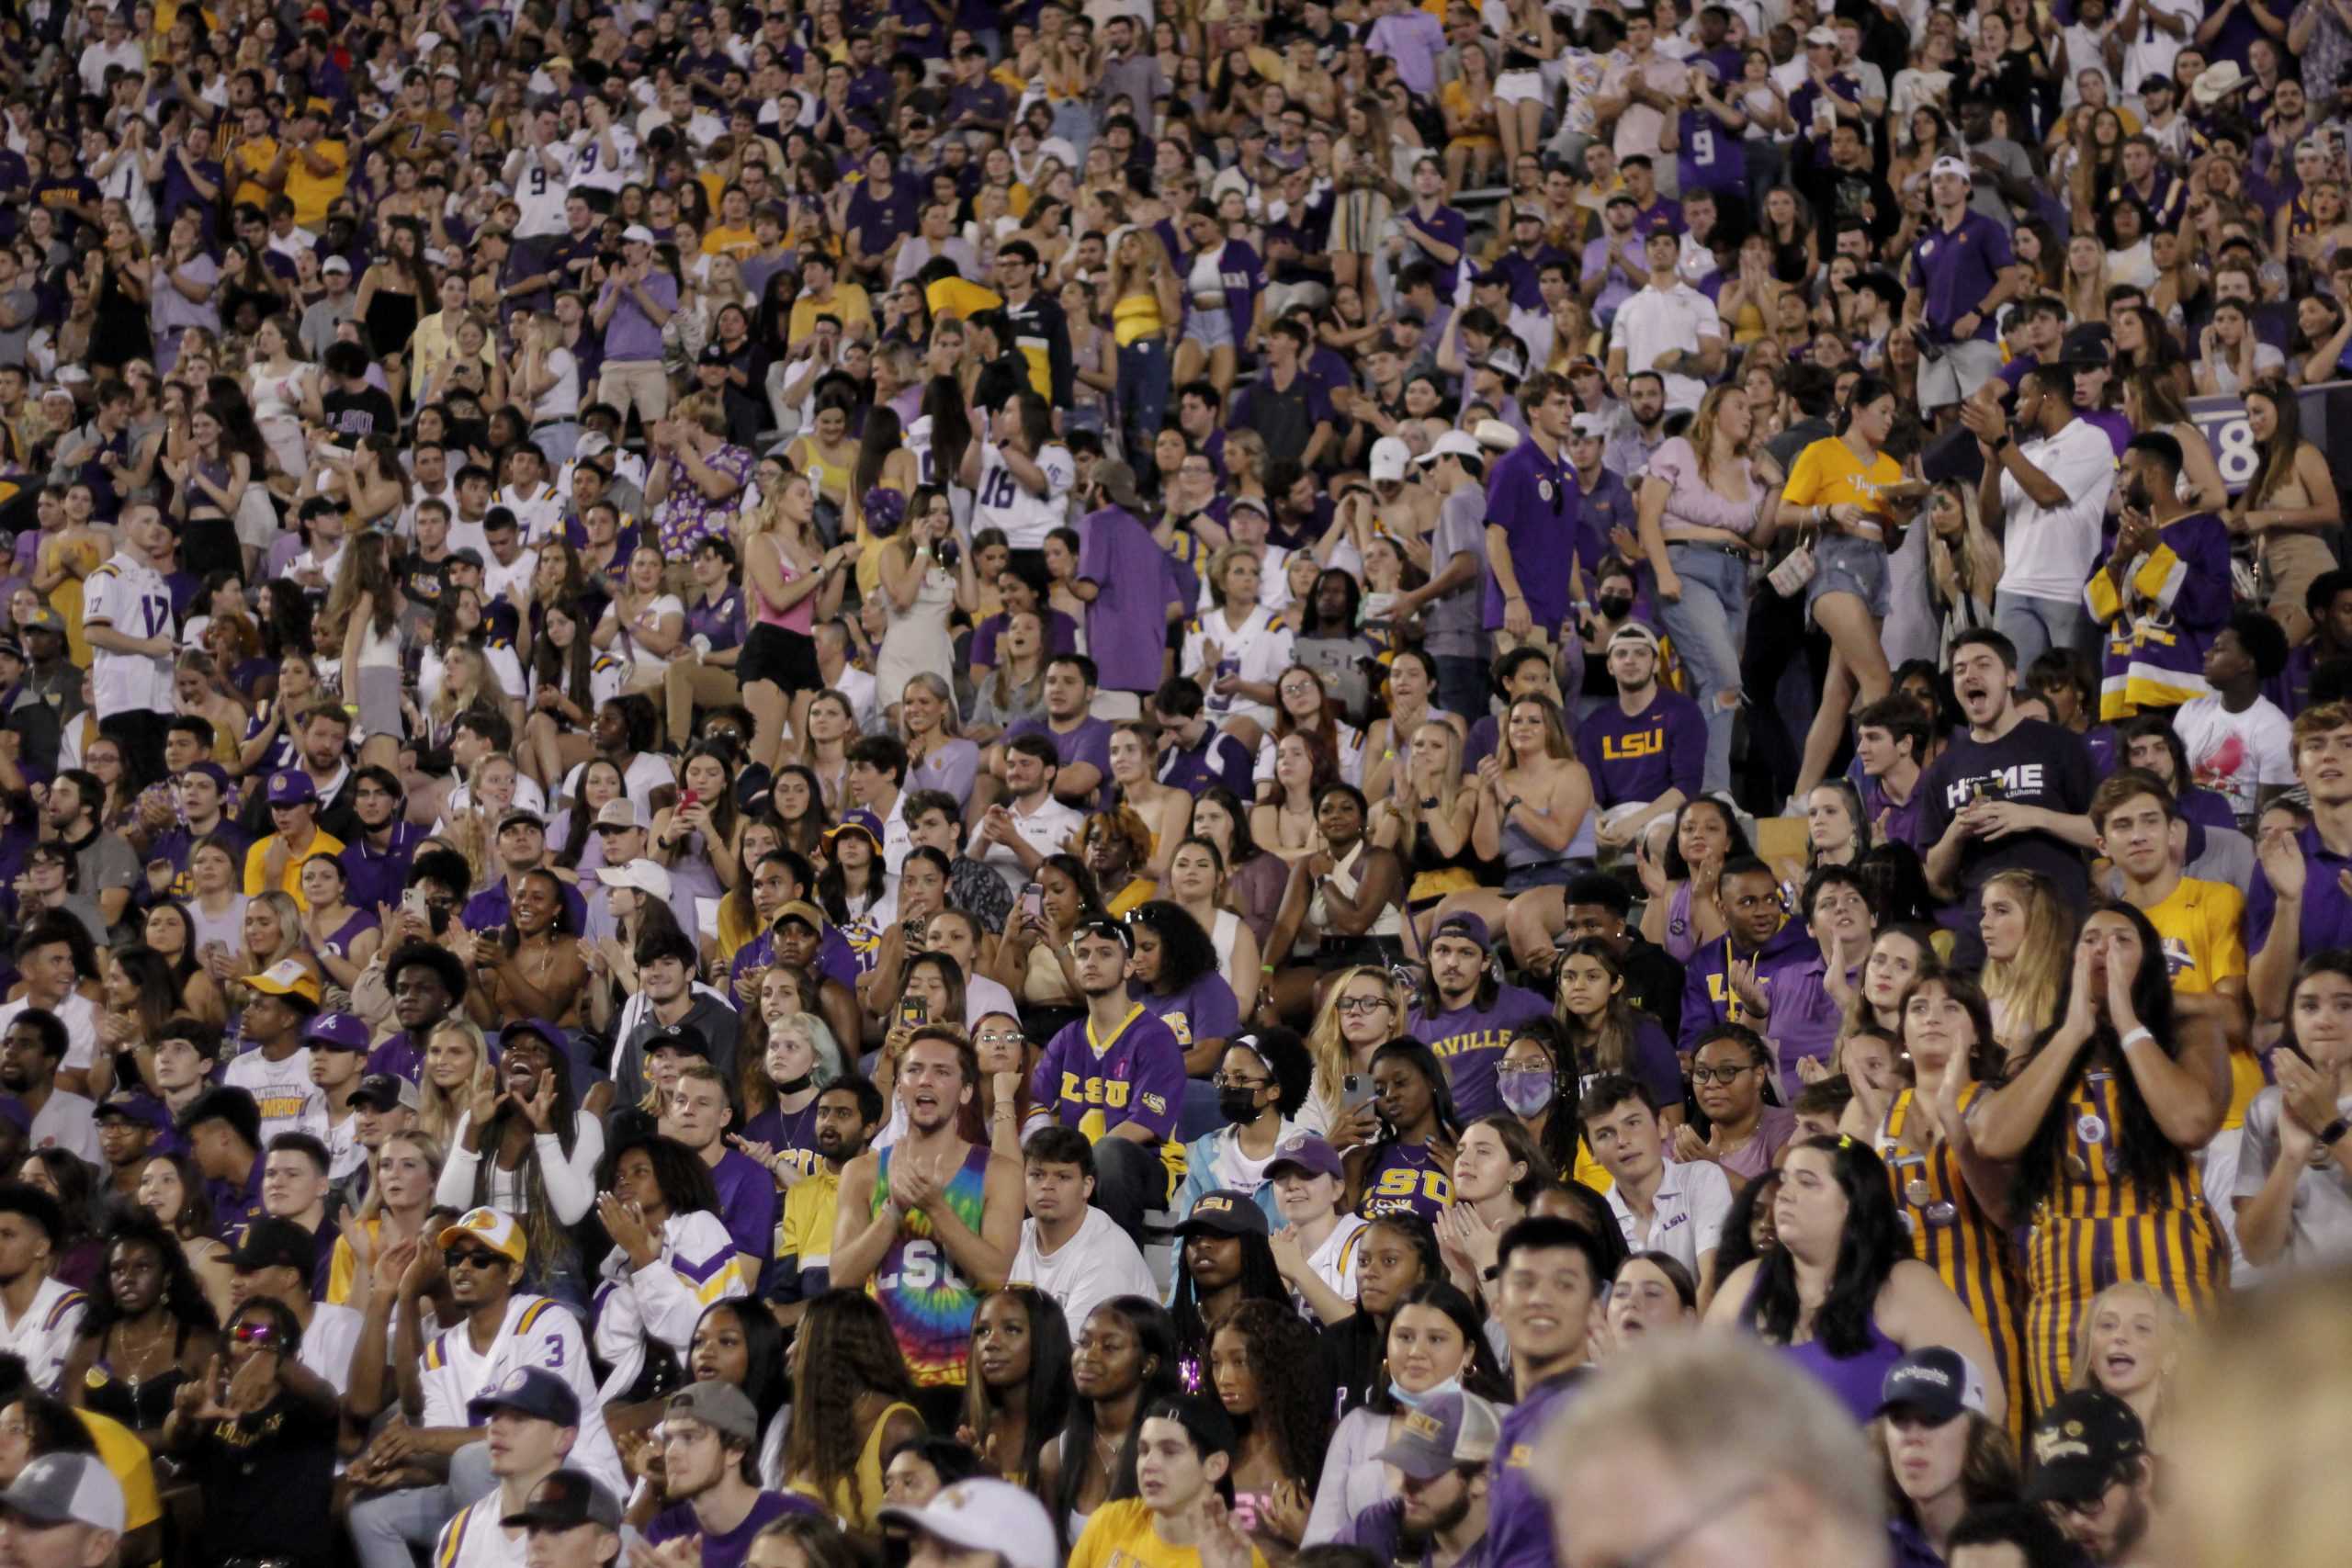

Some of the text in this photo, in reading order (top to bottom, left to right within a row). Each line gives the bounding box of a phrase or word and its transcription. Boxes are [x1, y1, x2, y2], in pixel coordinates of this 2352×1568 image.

[407, 121, 425, 151] 7
[1691, 129, 1715, 166] 9
[579, 142, 600, 175] 9
[124, 167, 133, 200] 1
[530, 166, 547, 196] 9
[979, 465, 1016, 509] 16
[89, 596, 103, 614] 17
[142, 593, 170, 639] 17
[277, 733, 296, 768] 7
[1602, 728, 1664, 761] LSU
[1946, 763, 2044, 809] HME
[1059, 1071, 1130, 1109] LSU
[1193, 1196, 1234, 1214] LSU
[1662, 1213, 1688, 1232] LSU
[544, 1333, 564, 1368] 3
